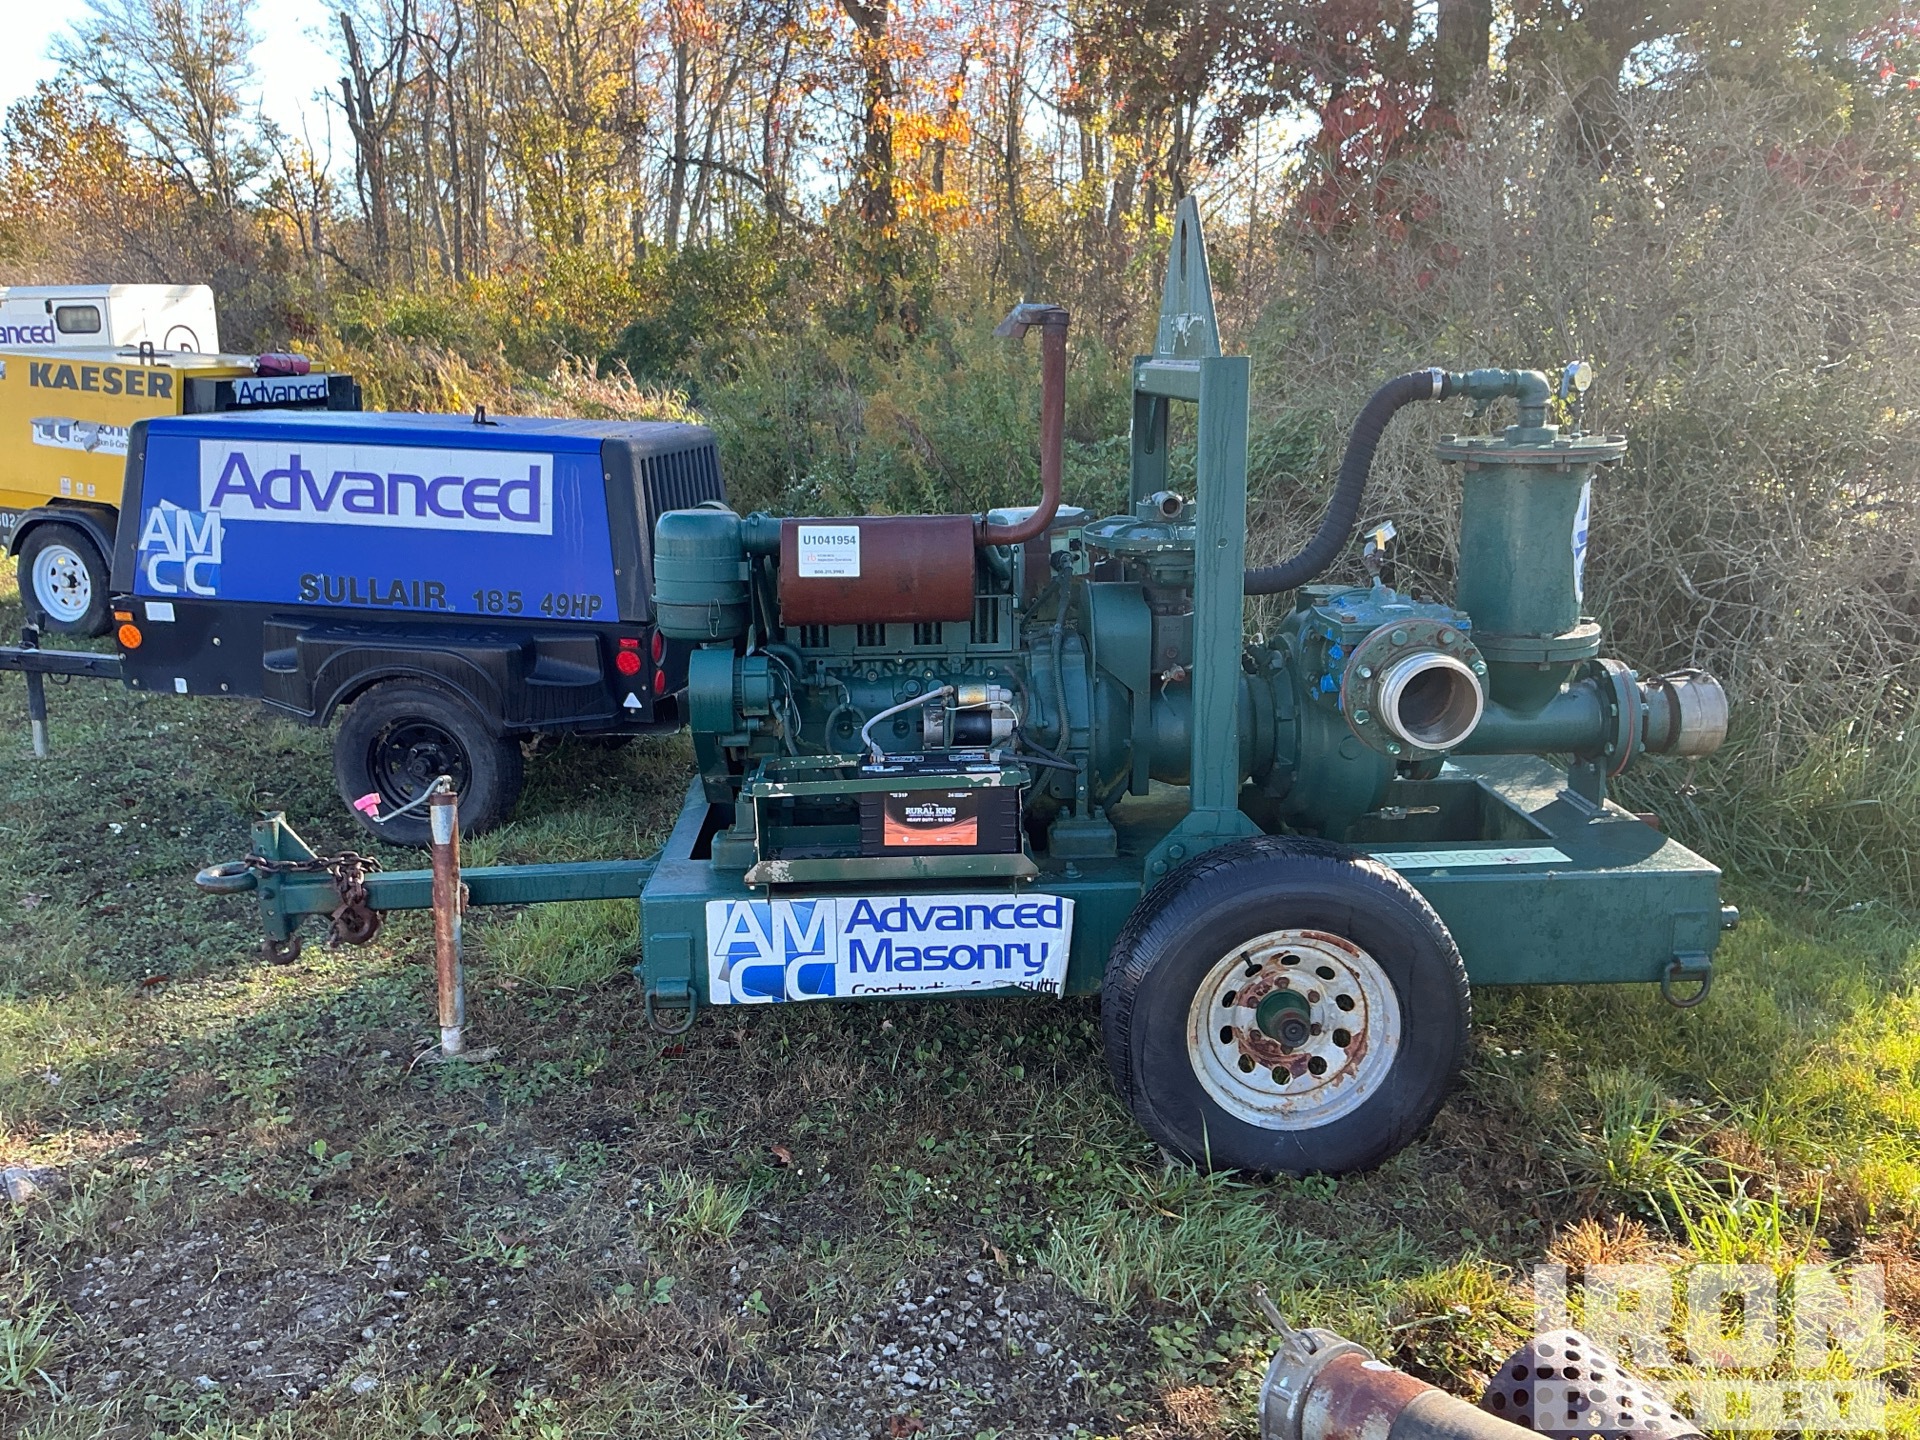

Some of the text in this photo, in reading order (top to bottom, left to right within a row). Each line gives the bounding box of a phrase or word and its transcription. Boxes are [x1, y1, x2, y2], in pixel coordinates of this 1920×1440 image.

[30, 361, 173, 399] KAESER
[239, 378, 328, 404] Advanced
[209, 452, 541, 524] Advanced
[803, 535, 856, 545] U1041954
[299, 573, 447, 610] SULLAIR
[472, 589, 523, 615] 185
[540, 593, 602, 620] 49HP
[905, 807, 956, 815] RURAL KING
[844, 898, 1063, 933] Advanced
[849, 938, 1049, 976] Masonry
